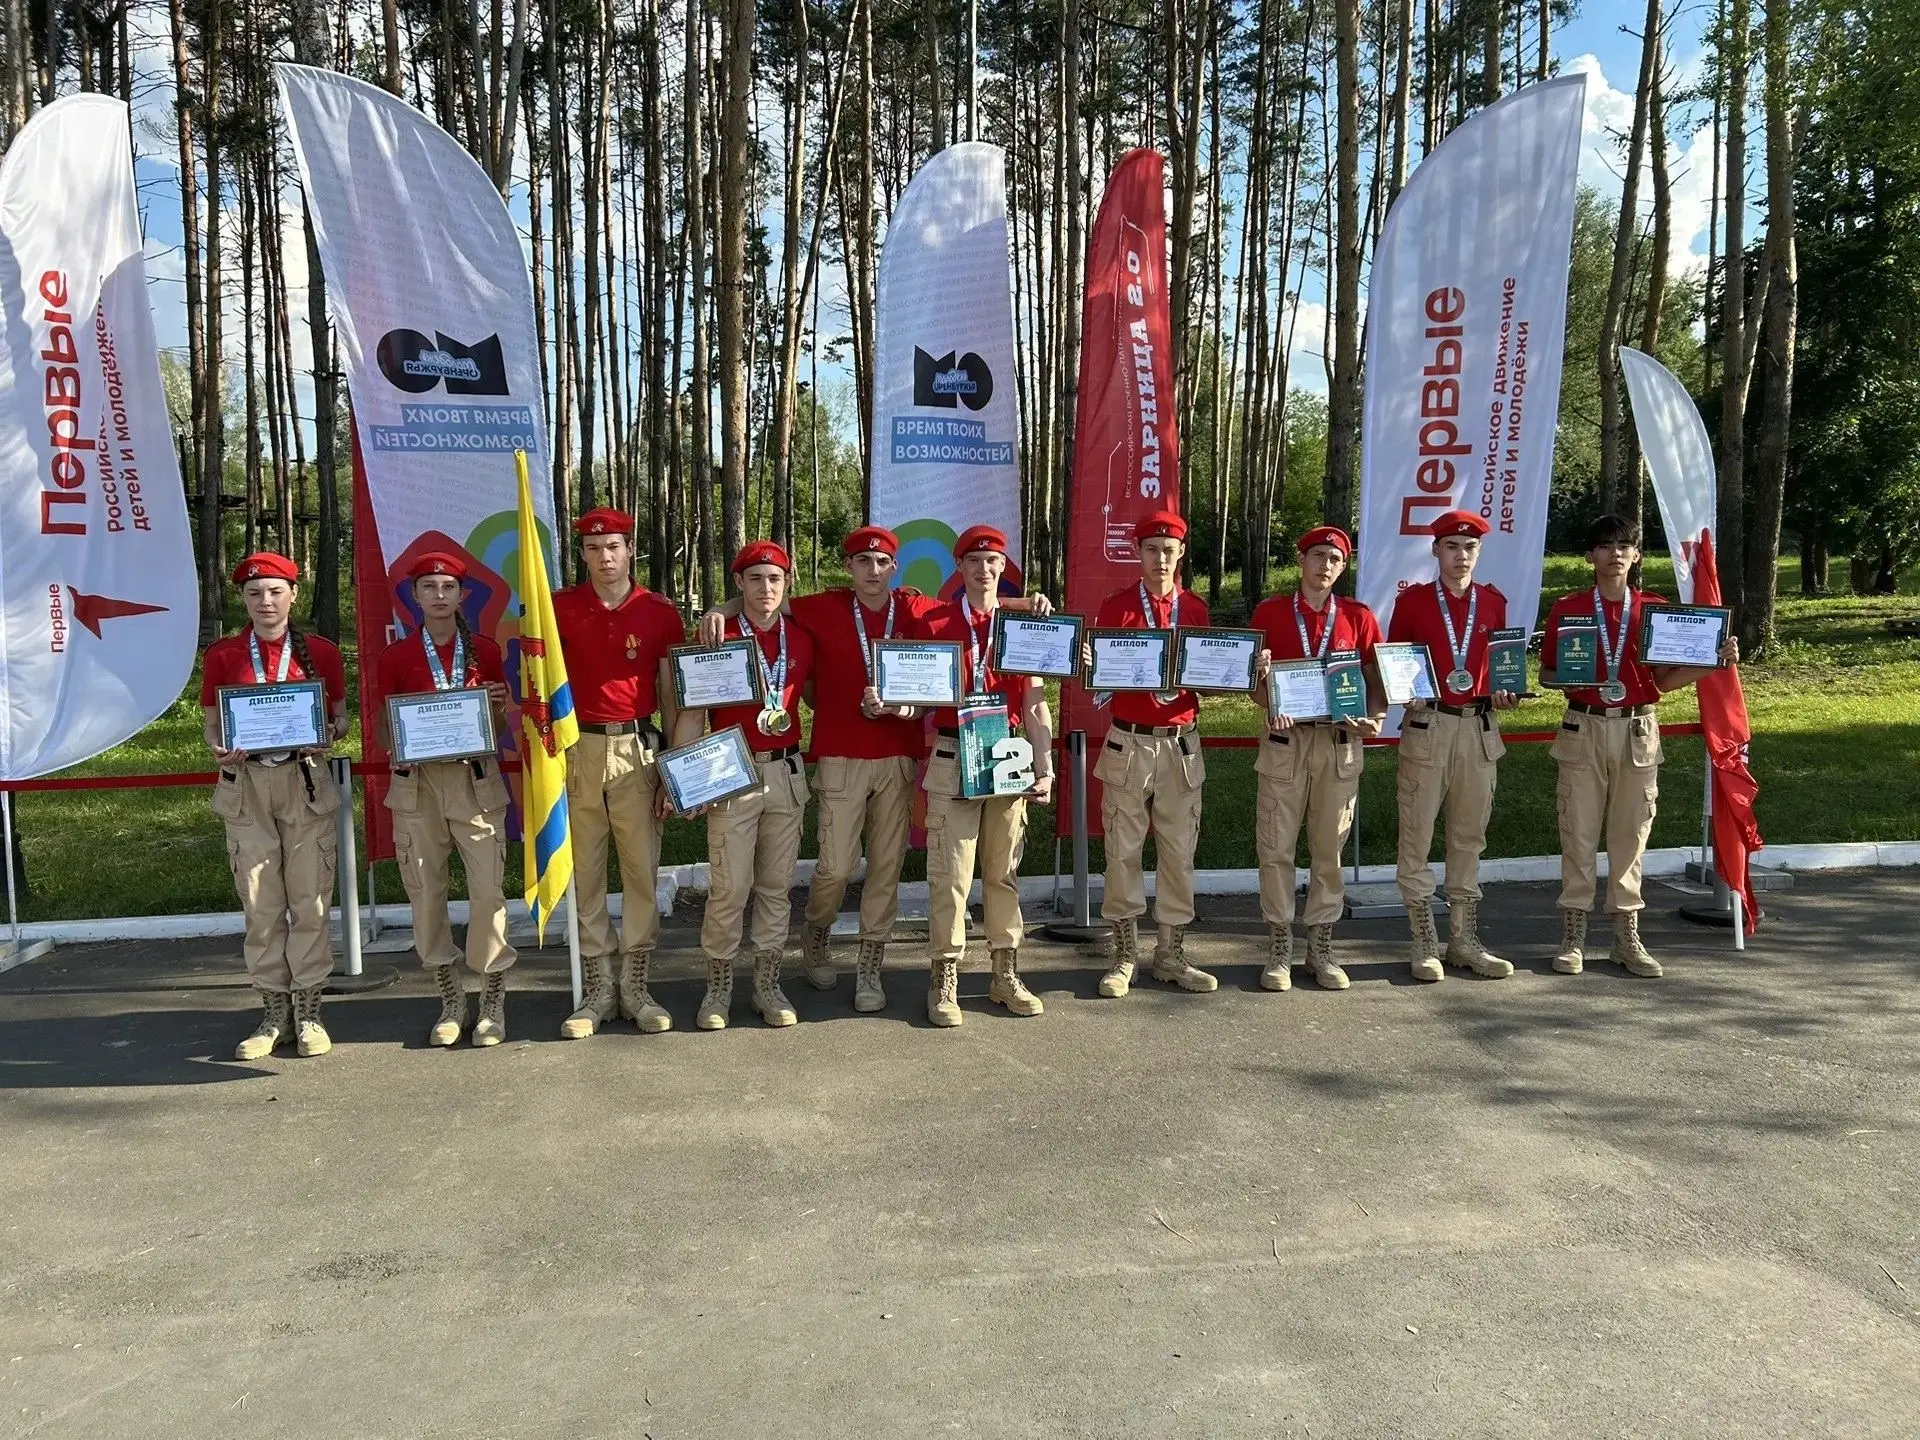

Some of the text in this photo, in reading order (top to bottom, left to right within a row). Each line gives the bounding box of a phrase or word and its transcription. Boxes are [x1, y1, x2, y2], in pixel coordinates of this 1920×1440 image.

[1126, 250, 1160, 499] ЗАРНИЦА 2.0
[39, 270, 96, 535] Первые
[1480, 277, 1516, 518] оссийское движение
[1399, 286, 1473, 536] Первые
[896, 421, 983, 439] ВРЕМЯ ТВОИХ
[1500, 321, 1529, 533] детей и молодёжи
[120, 448, 135, 461] и
[895, 443, 1011, 462] ВОЗМОЖНОСТЕЙ
[119, 468, 151, 531] детей
[49, 584, 66, 653] Первые
[1666, 615, 1707, 625] ДИПЛОМ
[1019, 622, 1060, 633] ДИПЛОМ
[1109, 640, 1148, 648] ДИПЛОМ
[1200, 639, 1240, 649] ДИПЛОМ
[1572, 637, 1581, 651] 1
[694, 652, 732, 664] ДИПЛОМ
[897, 652, 937, 661] ДИПЛОМ
[1502, 650, 1512, 664] 1
[1341, 672, 1351, 687] 1
[248, 694, 296, 707] ДИПЛОМ
[417, 701, 462, 715] ДИПЛОМ
[682, 744, 722, 765] ДИПЛОМ
[991, 737, 1035, 794] 2
